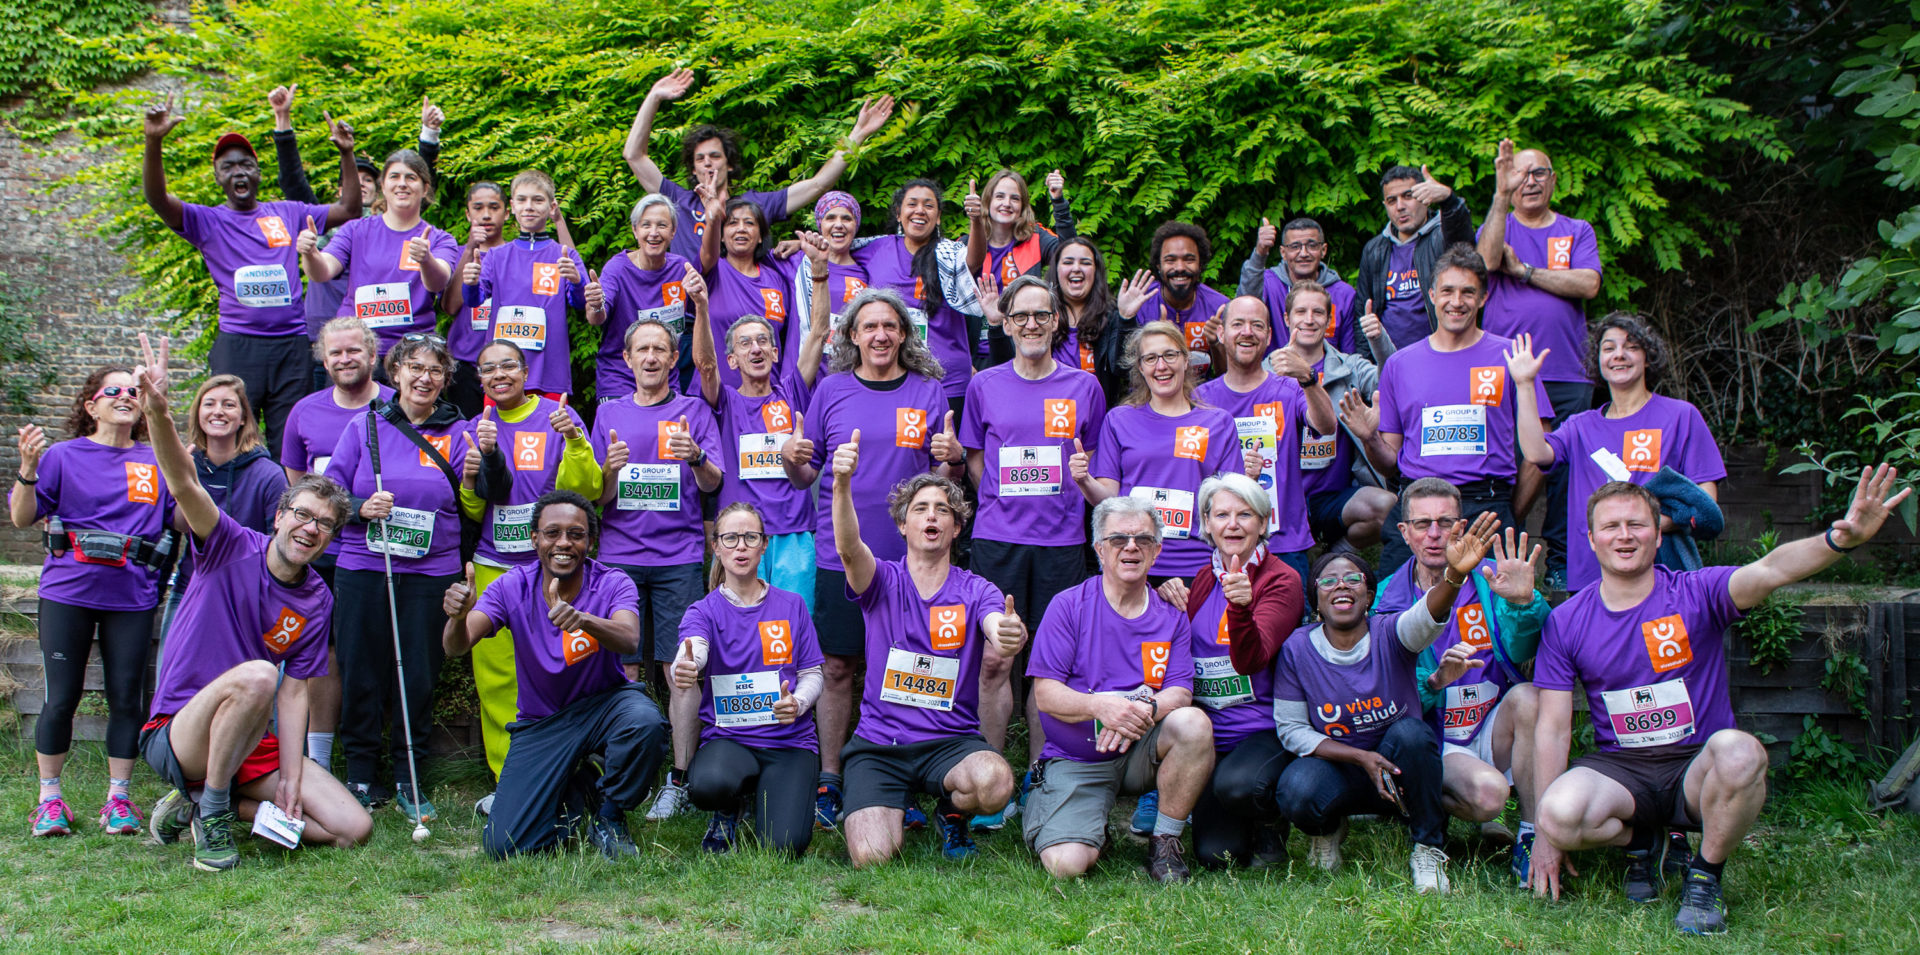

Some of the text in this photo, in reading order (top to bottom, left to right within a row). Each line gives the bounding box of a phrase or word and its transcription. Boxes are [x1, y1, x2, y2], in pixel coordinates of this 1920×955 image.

[243, 281, 286, 296] 38676
[361, 302, 405, 317] 27406
[500, 324, 539, 338] 14487
[1237, 420, 1261, 428] GROUP
[1428, 426, 1479, 443] 20785
[642, 467, 666, 475] GROUP
[1010, 468, 1050, 483] 8695
[624, 484, 673, 499] 34417
[395, 510, 420, 521] GROUP
[507, 507, 530, 517] GROUP
[1158, 510, 1185, 525] 10
[1204, 659, 1231, 669] GROUP
[736, 683, 754, 691] KBC
[895, 677, 947, 696] 14484
[721, 694, 774, 714] 18864
[1345, 696, 1383, 714] viva
[1352, 700, 1398, 725] salud
[1625, 708, 1677, 732] 8699
